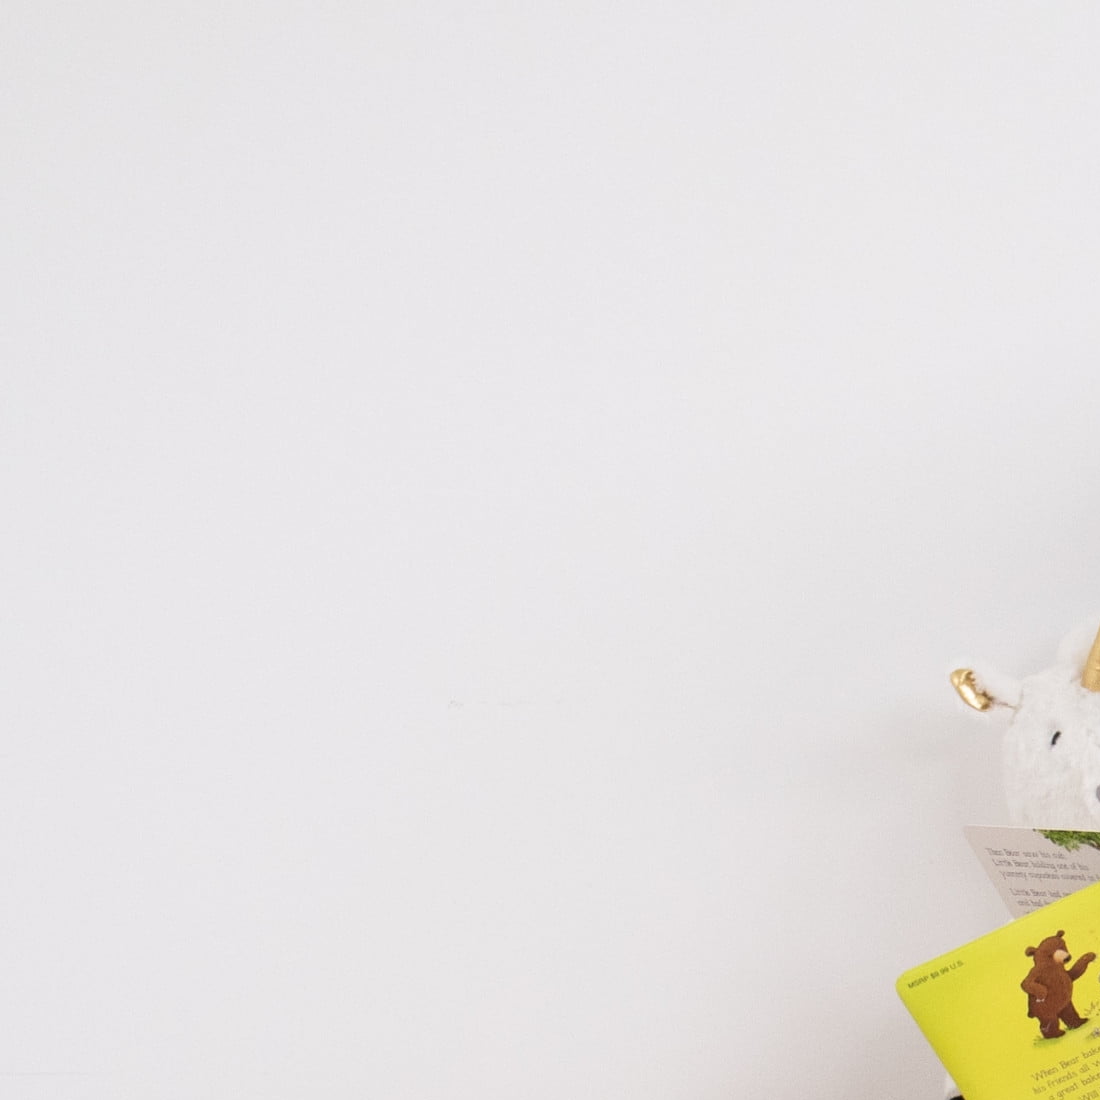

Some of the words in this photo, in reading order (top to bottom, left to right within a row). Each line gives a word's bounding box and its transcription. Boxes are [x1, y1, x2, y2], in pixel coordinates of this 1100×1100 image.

[1031, 1066, 1059, 1082] When
[1059, 1055, 1080, 1070] Bear
[1032, 1082, 1047, 1095] his
[1047, 1071, 1079, 1089] friends
[1079, 1062, 1091, 1075] all
[1049, 1093, 1055, 1100] a
[1057, 1083, 1079, 1100] great
